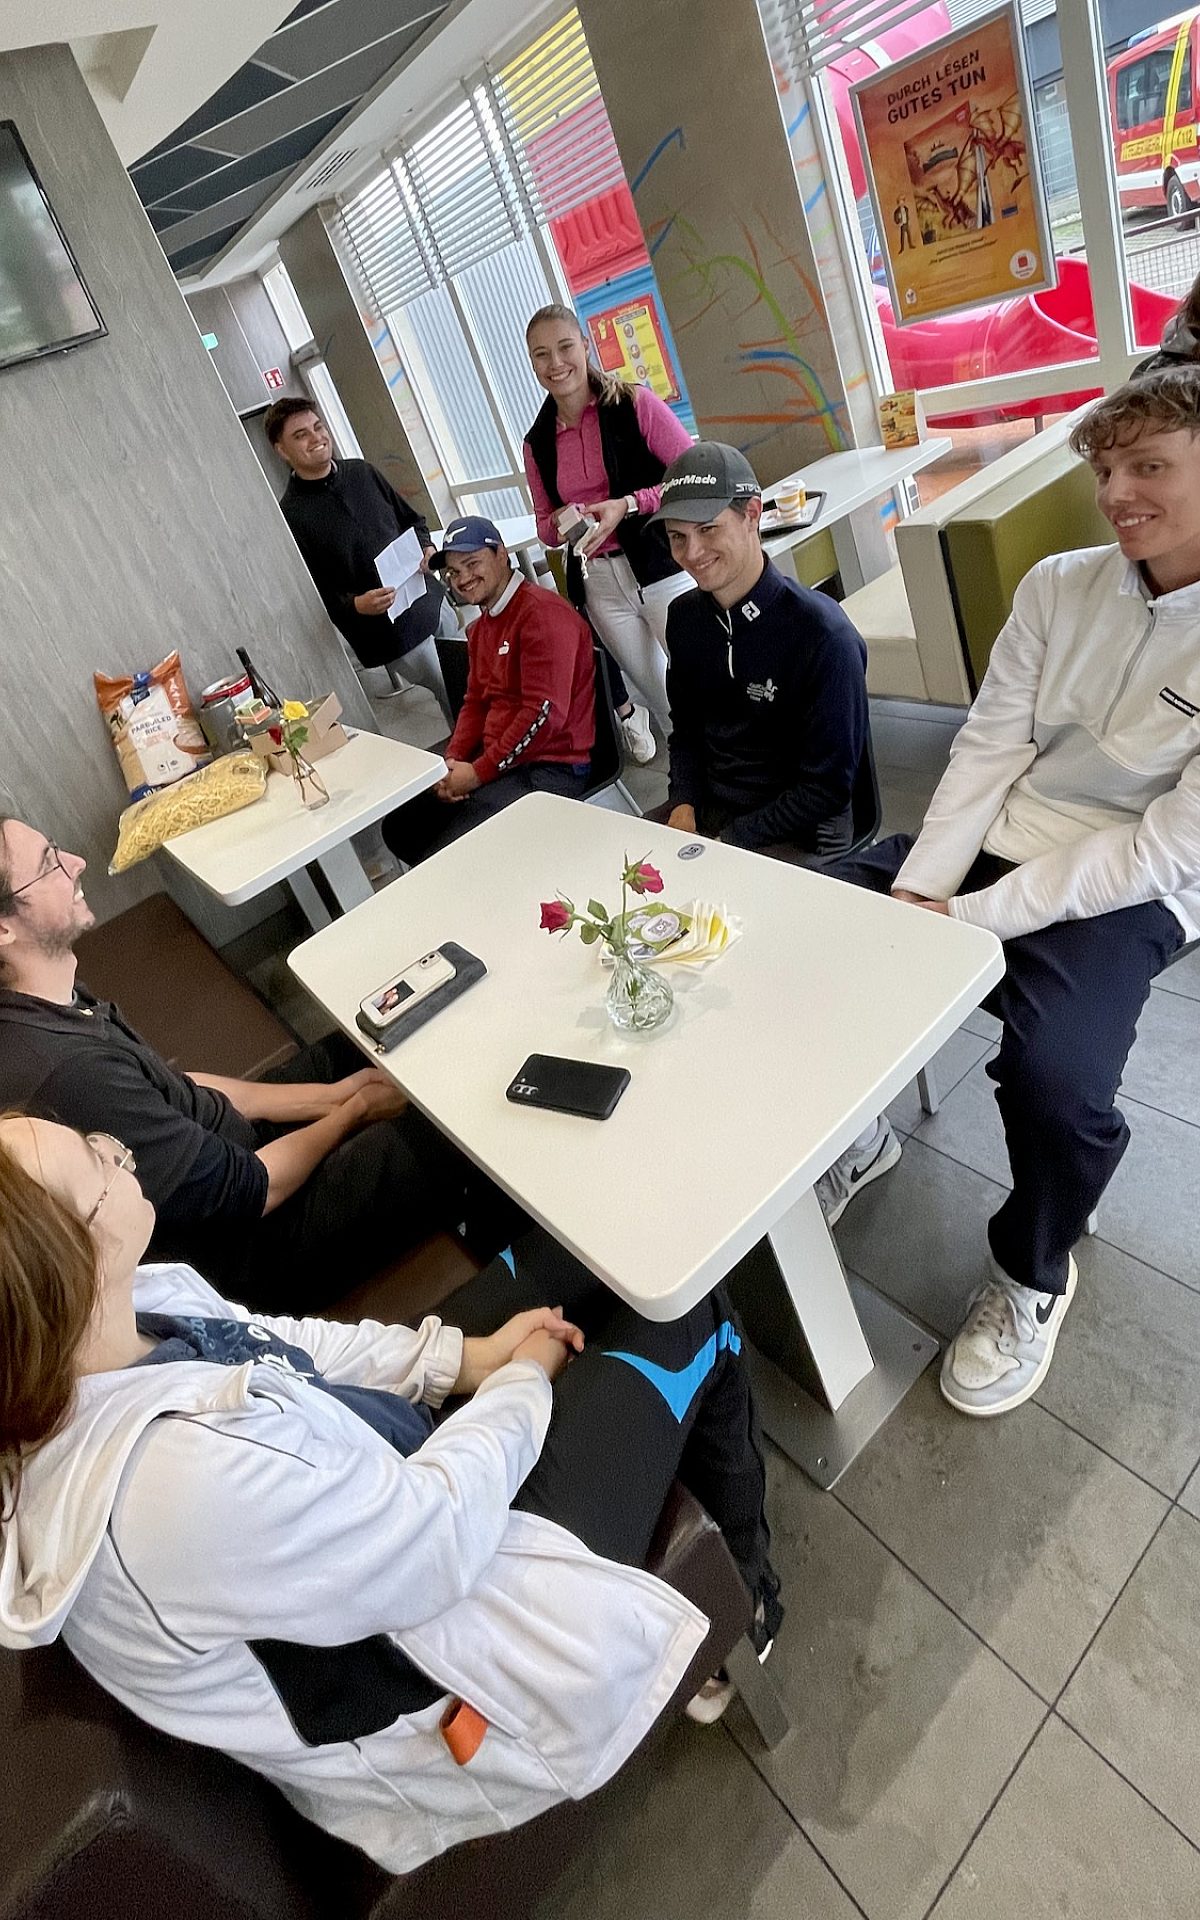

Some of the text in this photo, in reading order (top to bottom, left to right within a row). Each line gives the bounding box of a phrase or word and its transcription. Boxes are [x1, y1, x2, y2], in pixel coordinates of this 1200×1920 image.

[887, 49, 980, 106] DURCH LESEN
[888, 66, 986, 124] GUTES TUN
[144, 726, 162, 736] RICE
